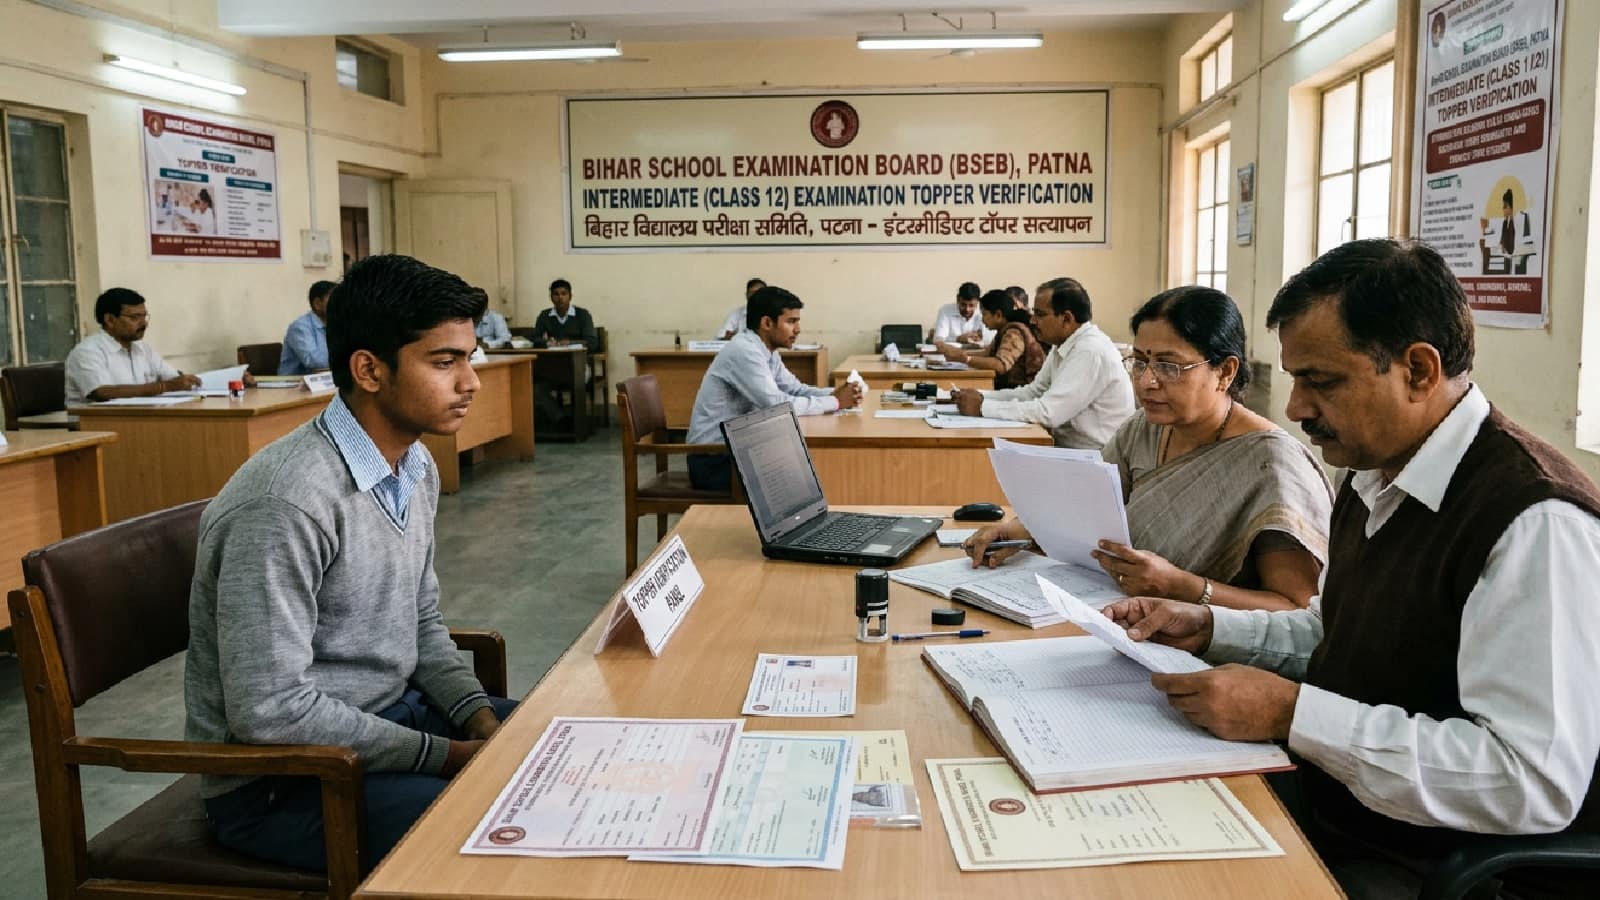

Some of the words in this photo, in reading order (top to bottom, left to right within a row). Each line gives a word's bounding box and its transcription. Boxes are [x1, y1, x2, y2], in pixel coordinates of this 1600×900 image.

[583, 157, 642, 180] BIHAR
[648, 156, 726, 179] SCHOOL
[733, 155, 868, 177] EXAMINATION
[875, 154, 943, 176] BOARD
[950, 153, 1020, 180] (BSEB),
[1028, 152, 1093, 174] PATNA
[583, 188, 698, 208] INTERMEDIATE
[703, 187, 760, 212] (CLASS
[765, 186, 789, 211] 12)
[794, 185, 905, 206] EXAMINATION
[910, 184, 974, 205] TOPPER
[979, 183, 1093, 204] VERIFICATION
[584, 214, 630, 239] बिहार
[633, 213, 698, 237] विद्यालय
[702, 213, 750, 236] परीक्षा
[754, 213, 813, 237] समिति,
[819, 218, 863, 235] पटना
[978, 211, 1019, 234] टॉपर
[1023, 216, 1093, 234] सत्यापन
